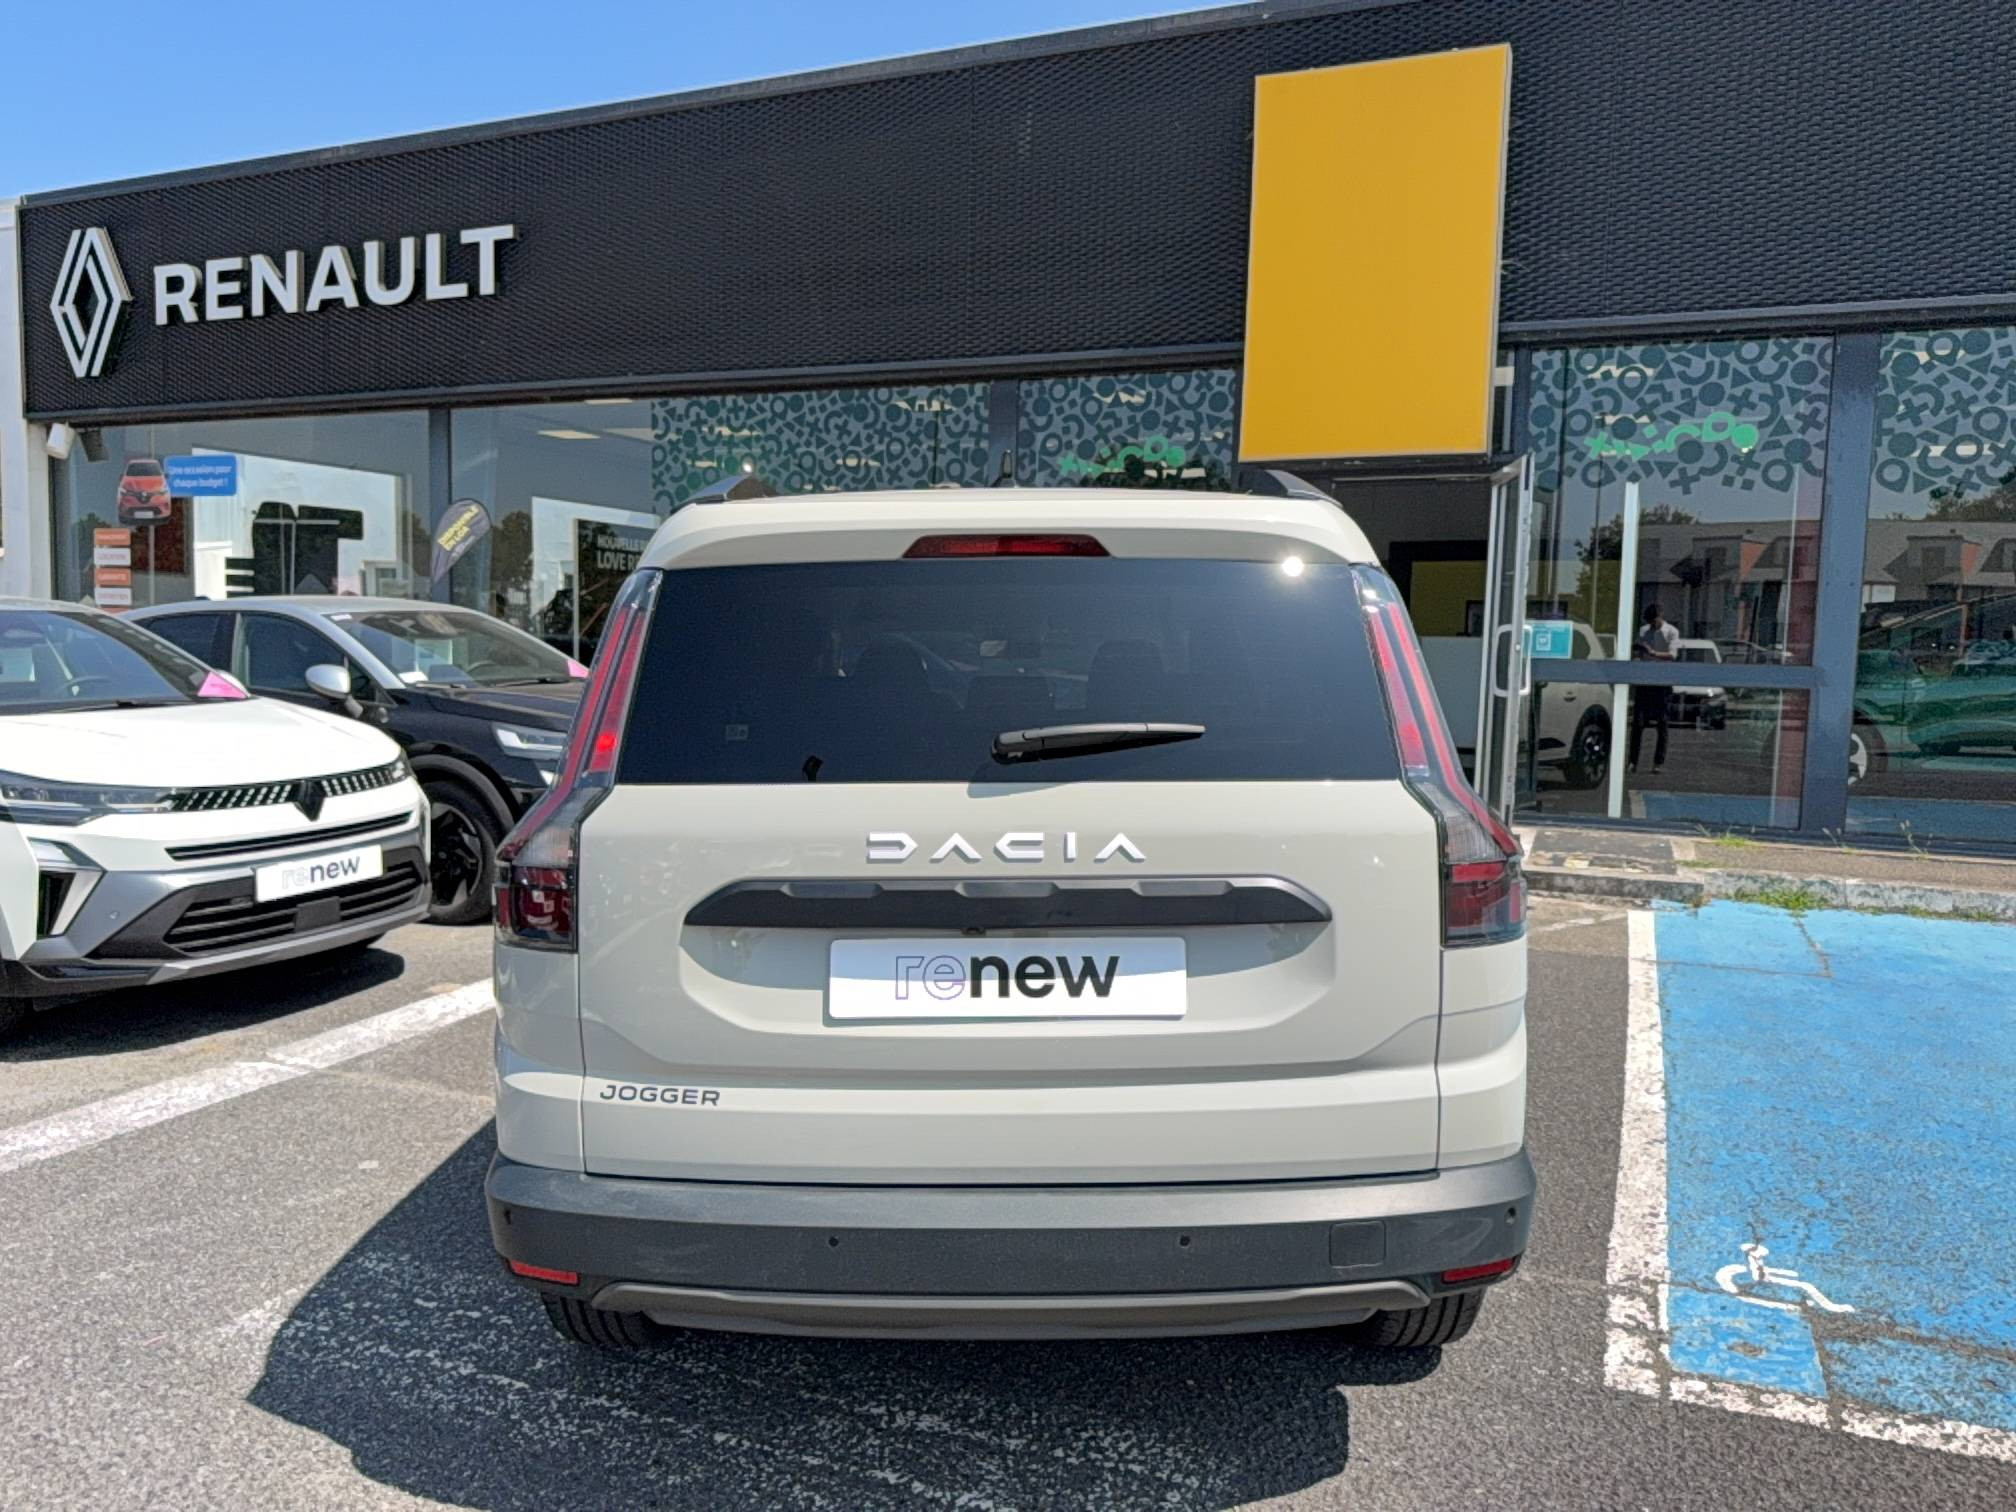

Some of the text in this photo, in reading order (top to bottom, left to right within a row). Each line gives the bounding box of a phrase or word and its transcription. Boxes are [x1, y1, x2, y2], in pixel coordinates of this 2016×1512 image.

[153, 224, 516, 325] RENAULT
[597, 549, 627, 571] LOVE
[866, 832, 1147, 863] DACIA
[281, 856, 361, 889] renew
[895, 955, 1121, 1000] renew
[599, 1084, 721, 1106] JOGGER
